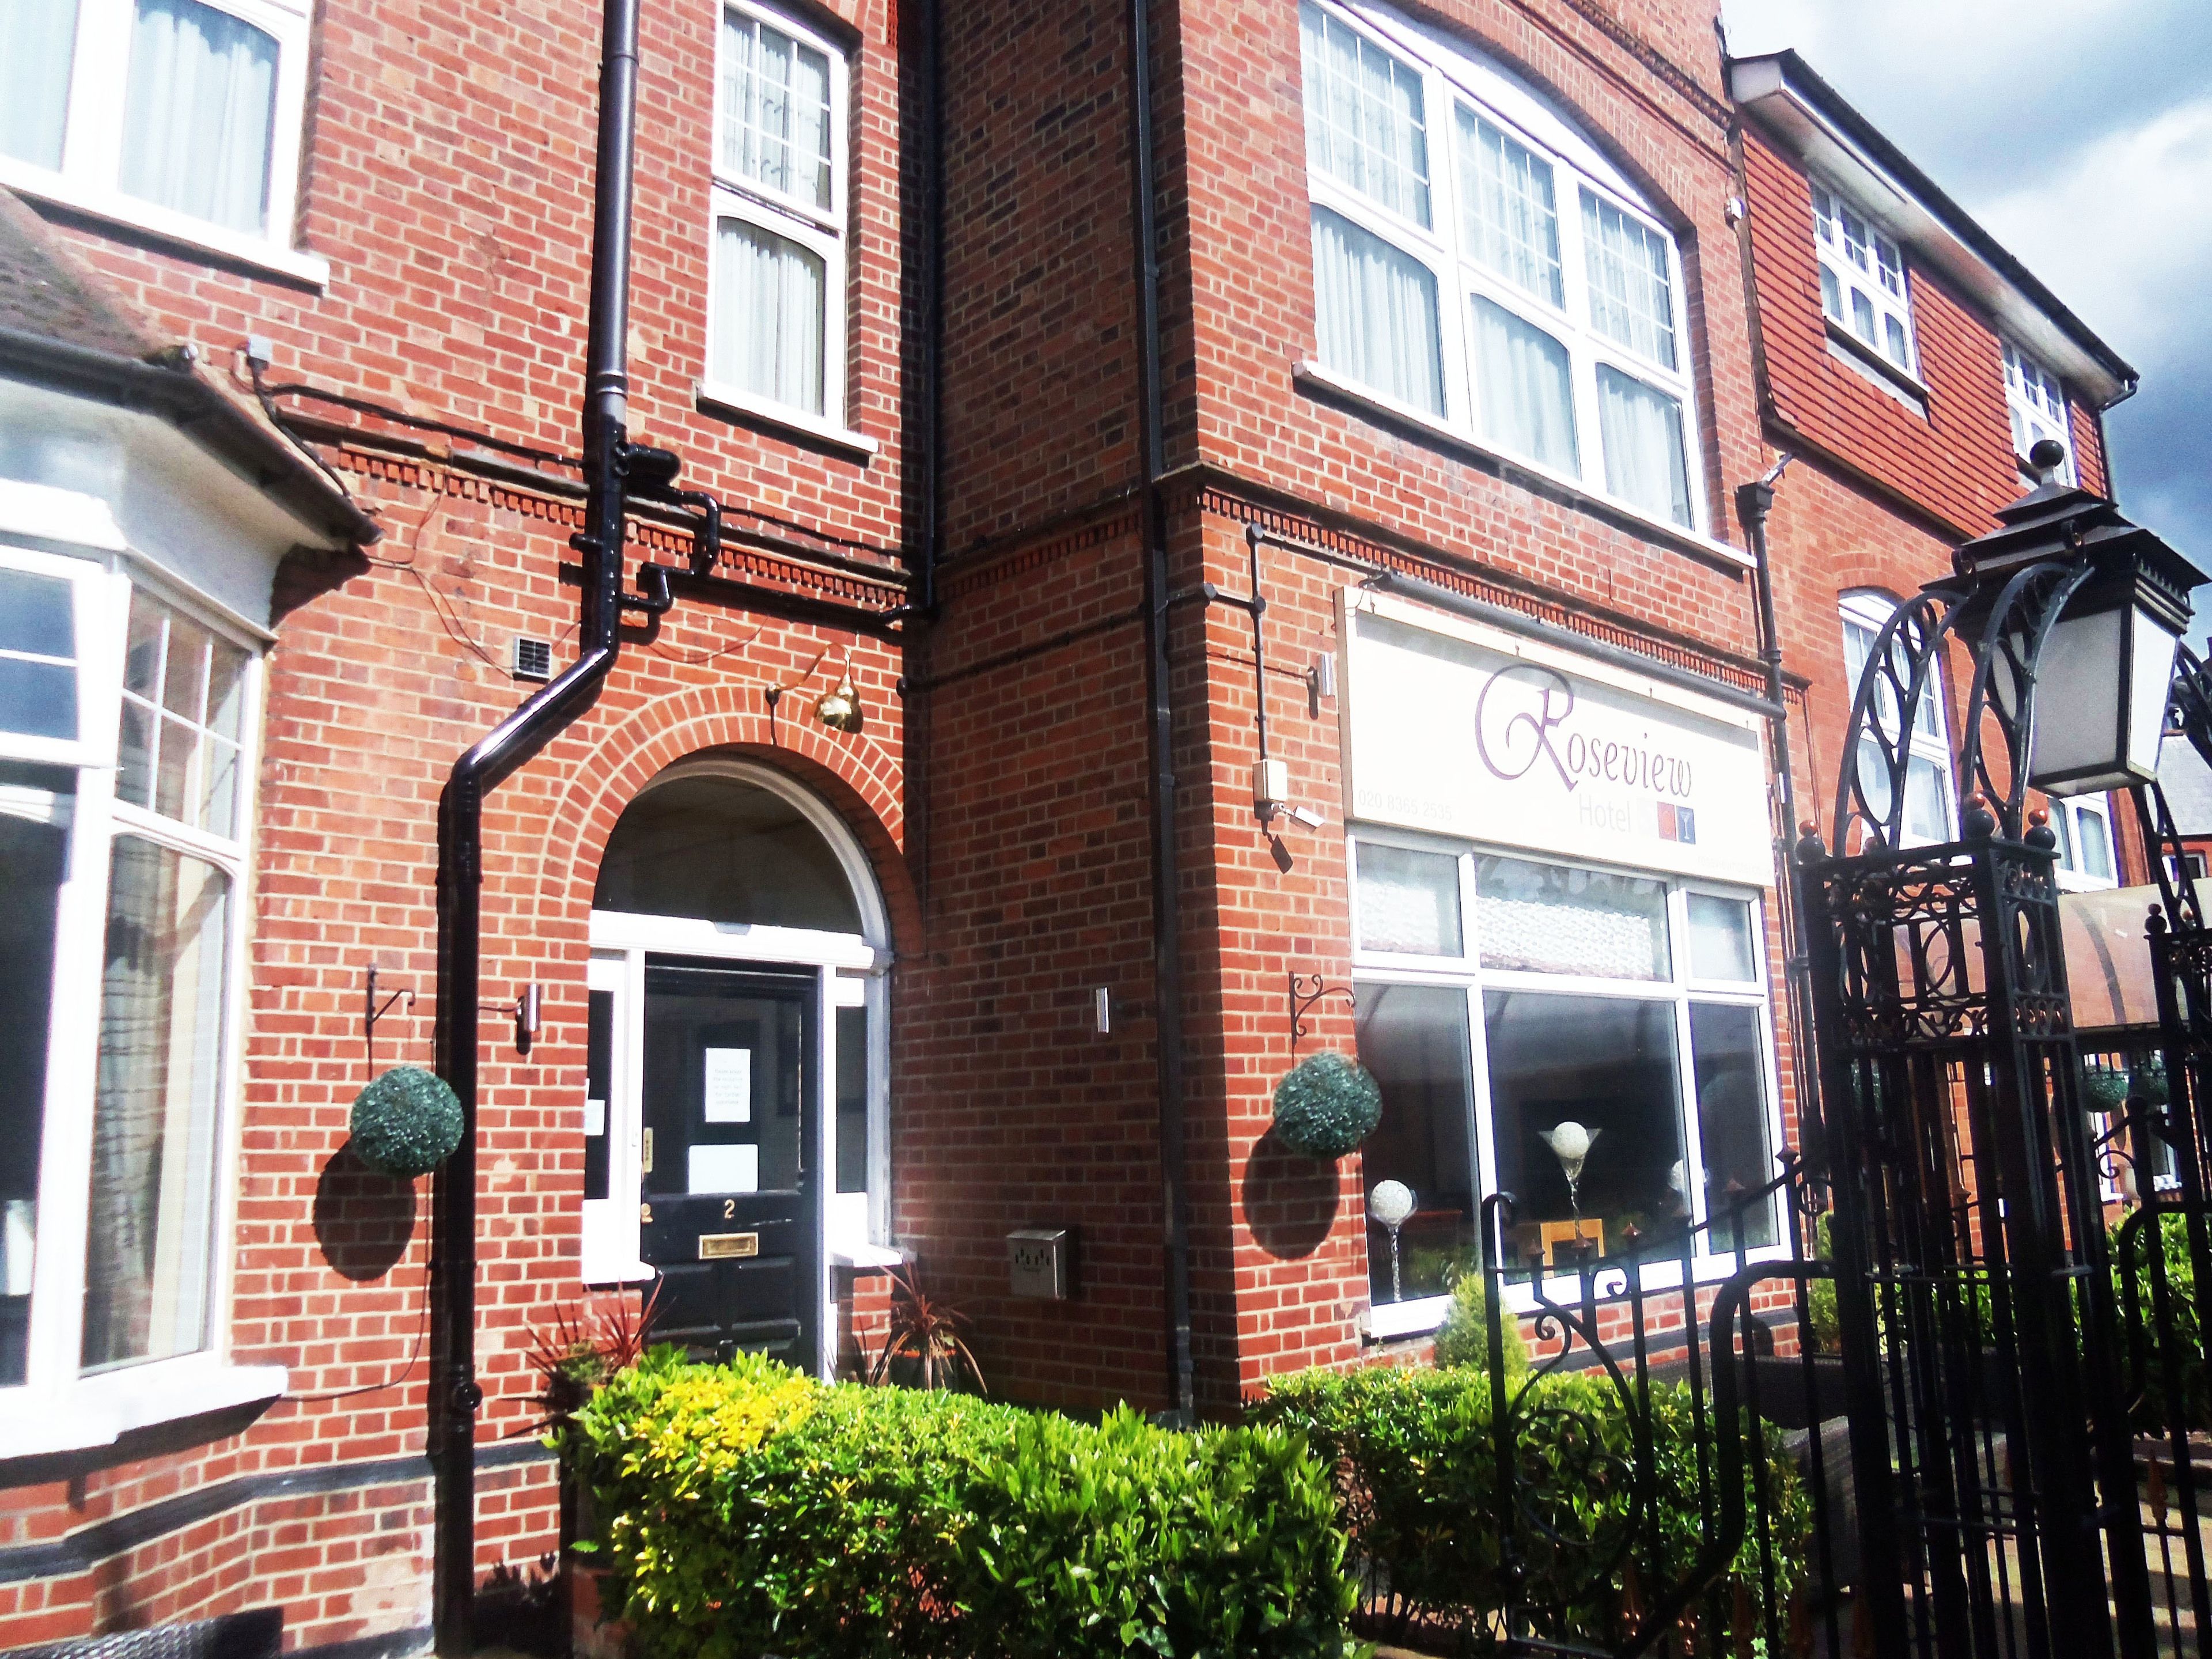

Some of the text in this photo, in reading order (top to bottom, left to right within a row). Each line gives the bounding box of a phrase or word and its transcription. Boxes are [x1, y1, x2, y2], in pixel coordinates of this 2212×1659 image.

[1475, 664, 1691, 797] Roseview
[1358, 789, 1452, 821] 020 8365 2535
[1578, 793, 1631, 833] Hotel
[724, 1199, 735, 1219] 2
